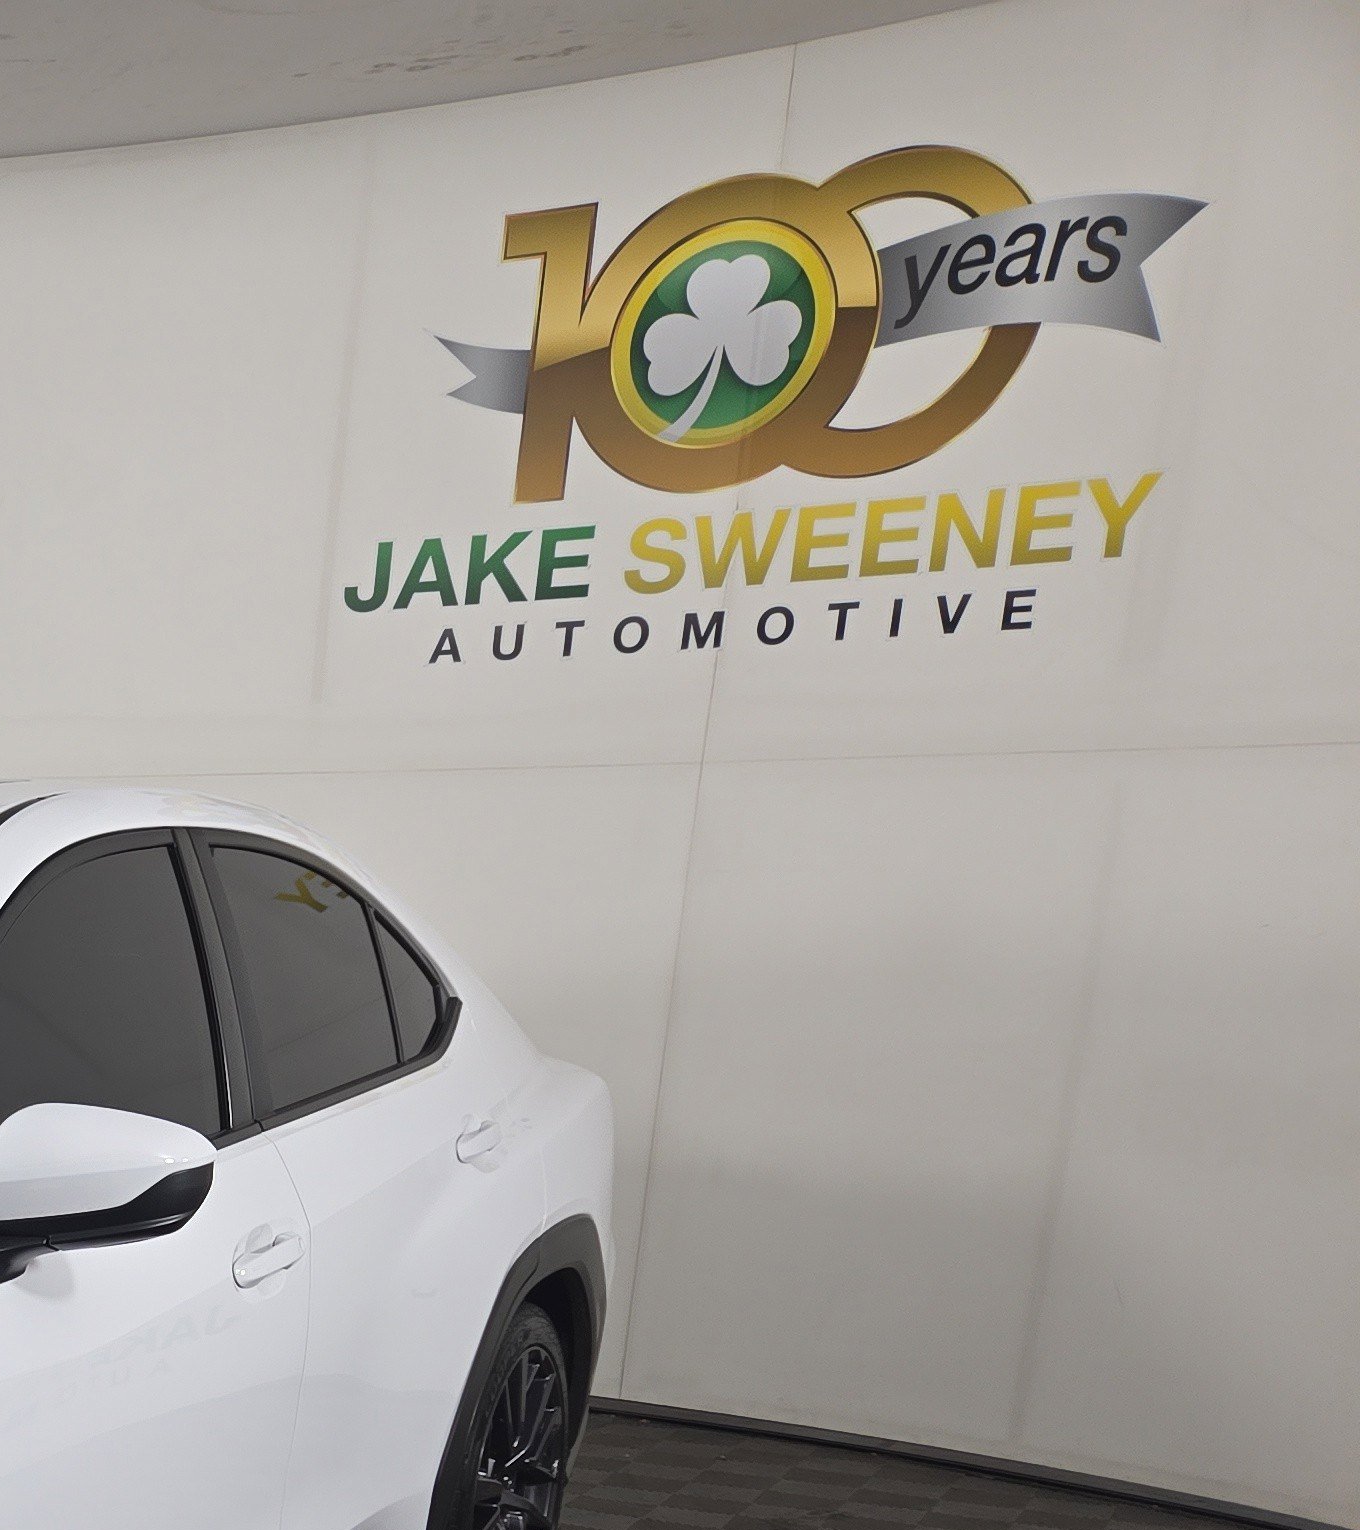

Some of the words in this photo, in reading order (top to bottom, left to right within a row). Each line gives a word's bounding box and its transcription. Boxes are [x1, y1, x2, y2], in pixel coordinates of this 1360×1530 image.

[893, 214, 1128, 330] years
[343, 524, 596, 614] JAKE
[624, 471, 1162, 595] SWEENEY
[428, 589, 1038, 665] AUTOMOTIVE
